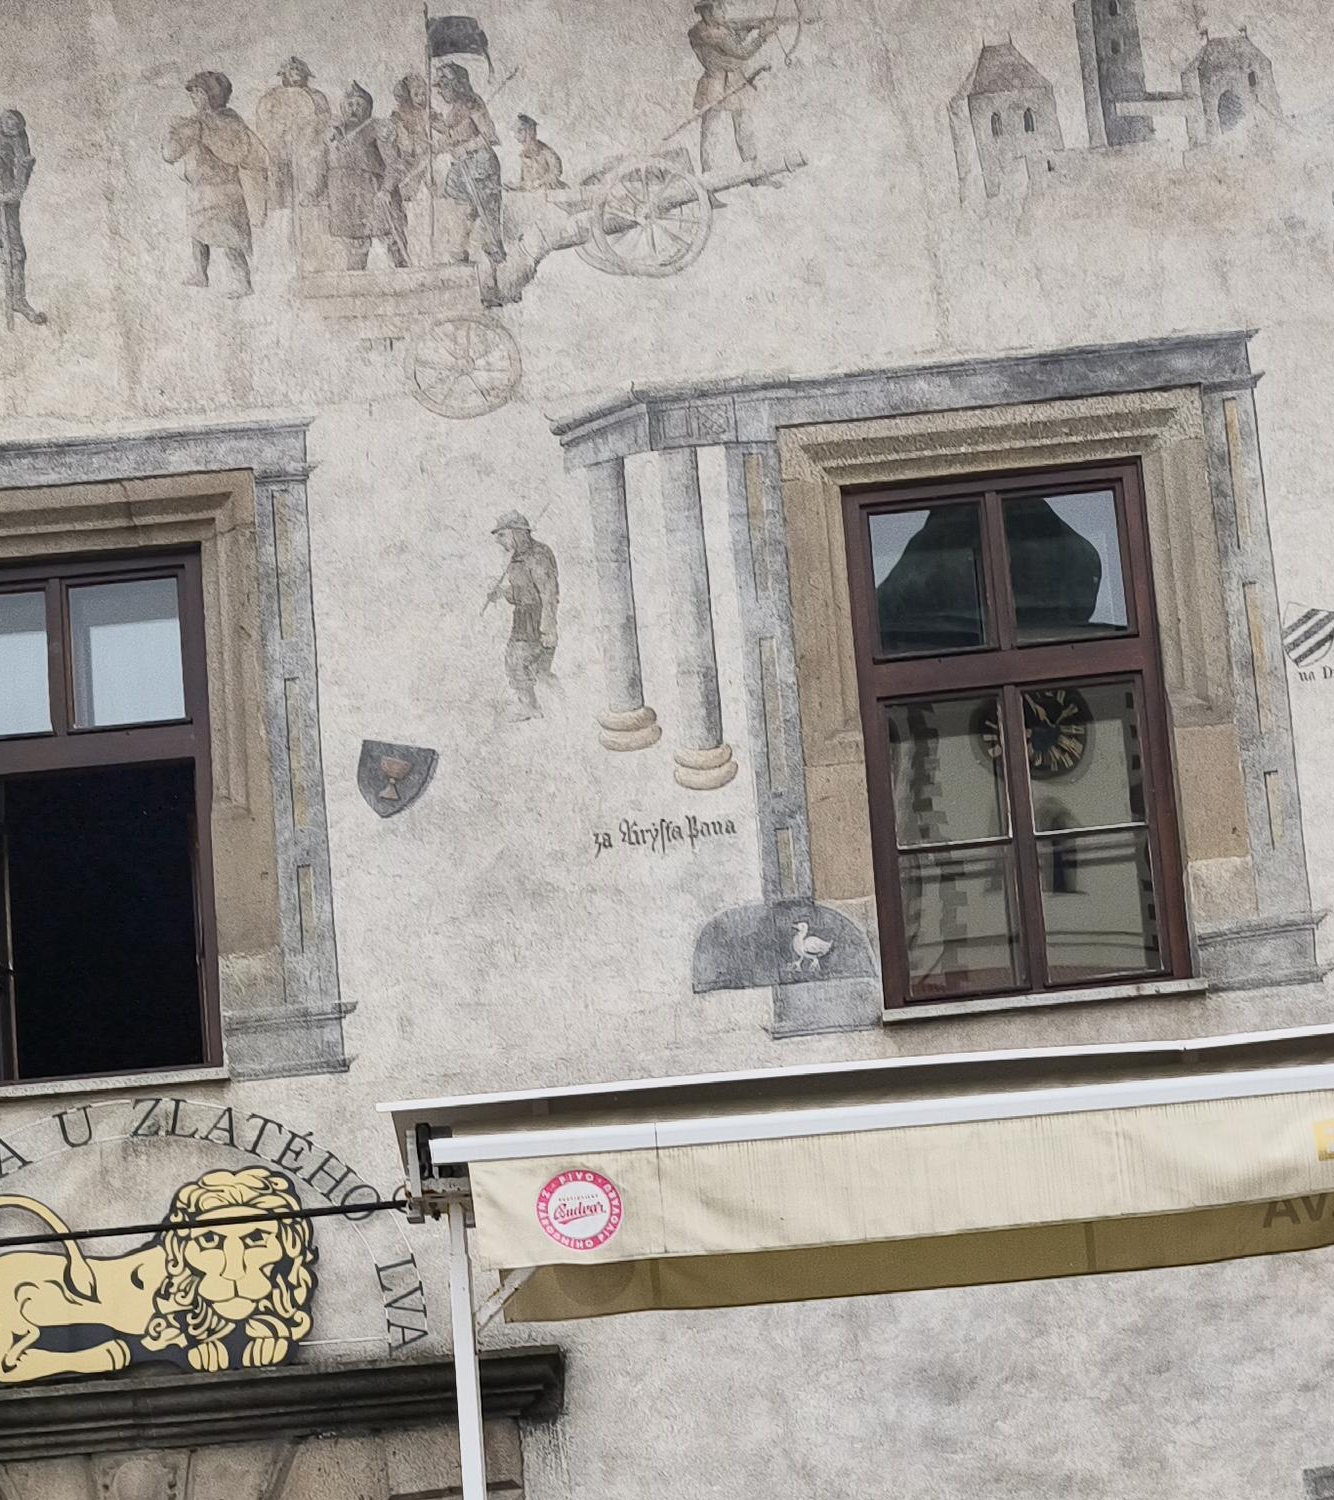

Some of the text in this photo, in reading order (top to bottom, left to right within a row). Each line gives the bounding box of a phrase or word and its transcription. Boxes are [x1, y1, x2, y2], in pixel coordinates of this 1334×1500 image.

[559, 1172, 594, 1184] PIVO
[553, 1201, 607, 1224] Budvar
[53, 1105, 97, 1148] U
[131, 1097, 383, 1222] ZLATÉHO
[375, 1251, 428, 1356] LVA
